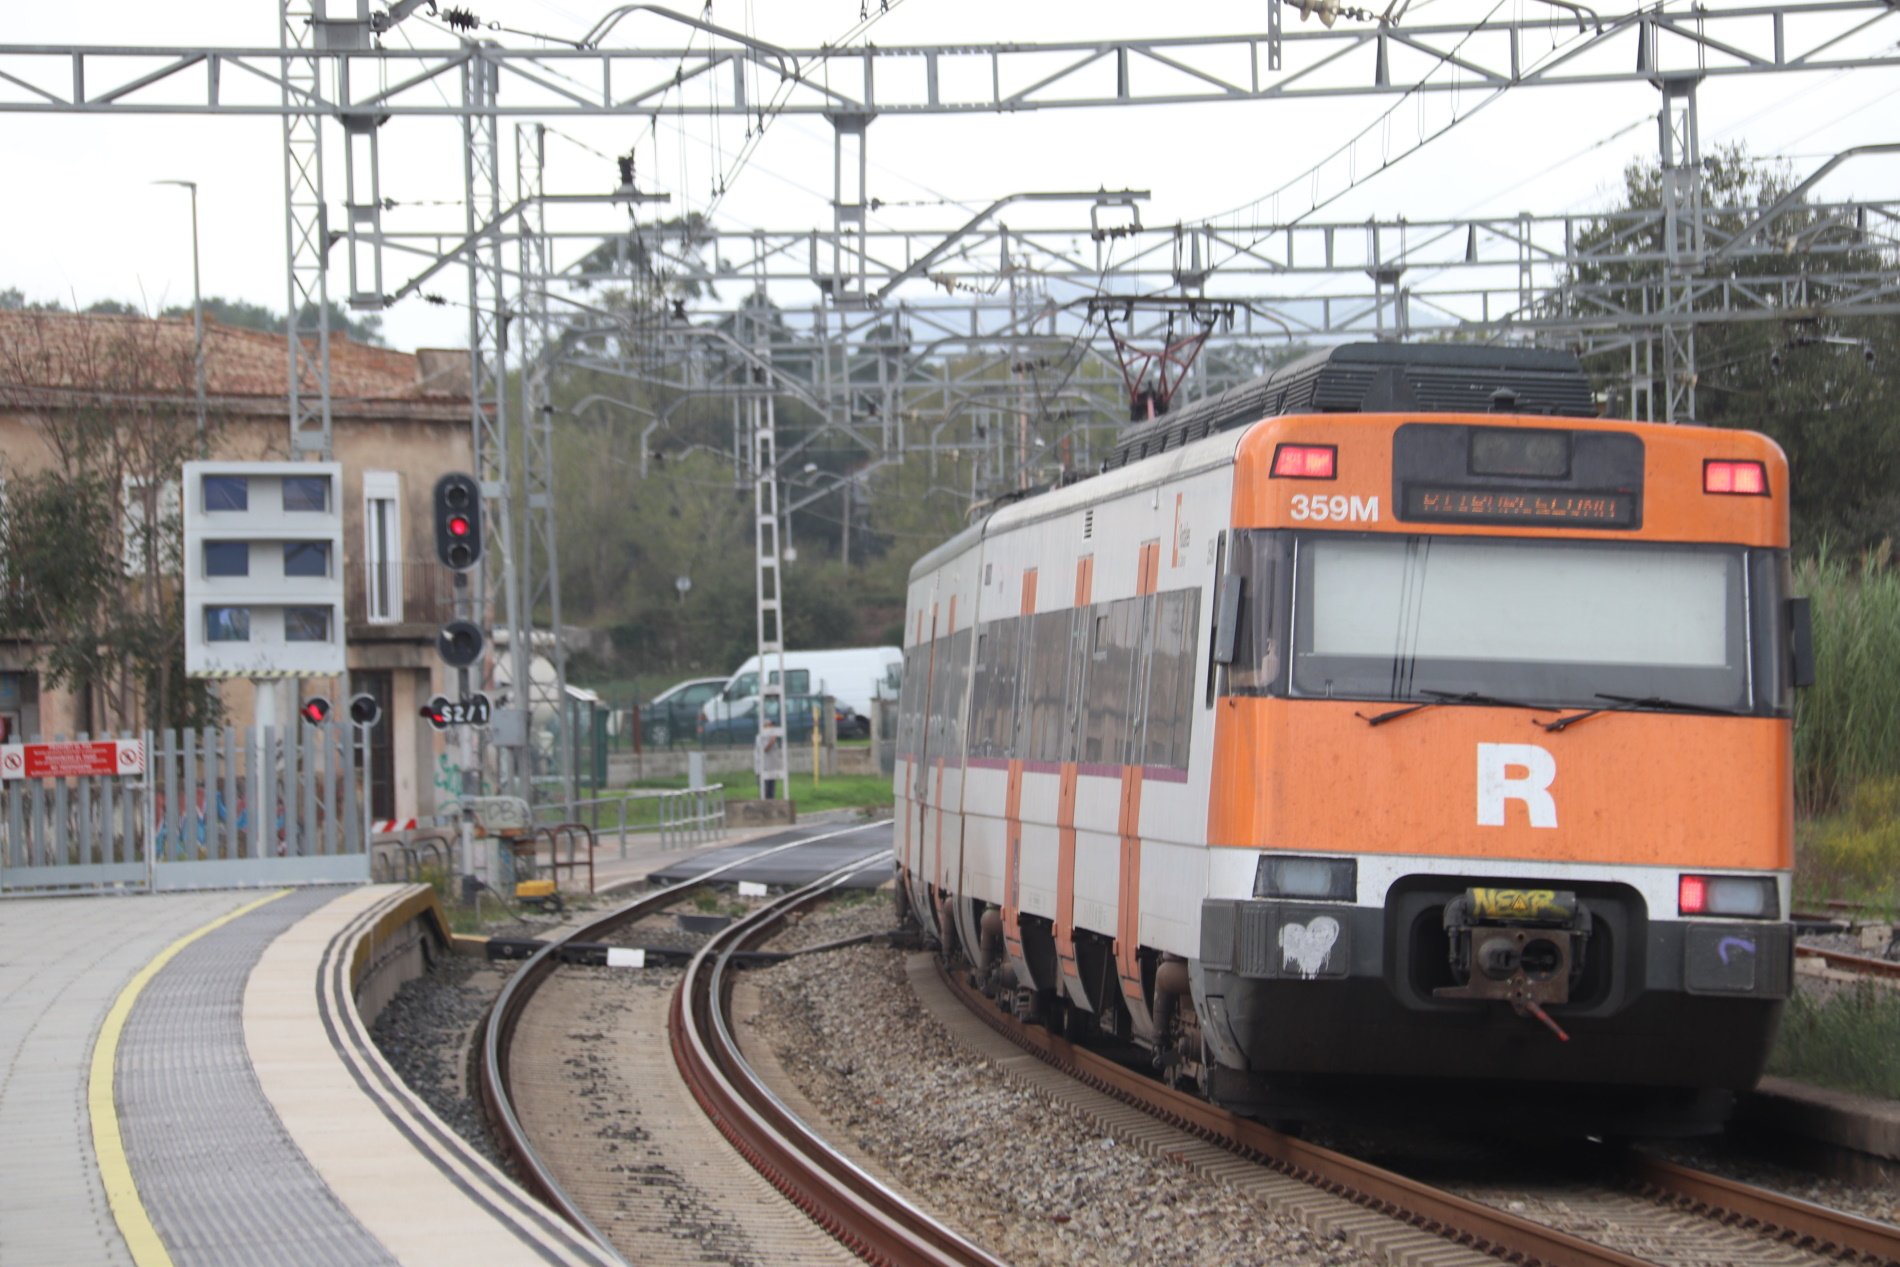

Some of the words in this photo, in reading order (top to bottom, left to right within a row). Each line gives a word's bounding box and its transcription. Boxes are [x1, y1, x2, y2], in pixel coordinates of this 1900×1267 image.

[1290, 494, 1379, 522] 359M
[441, 705, 487, 722] S2/1
[1477, 742, 1558, 828] R
